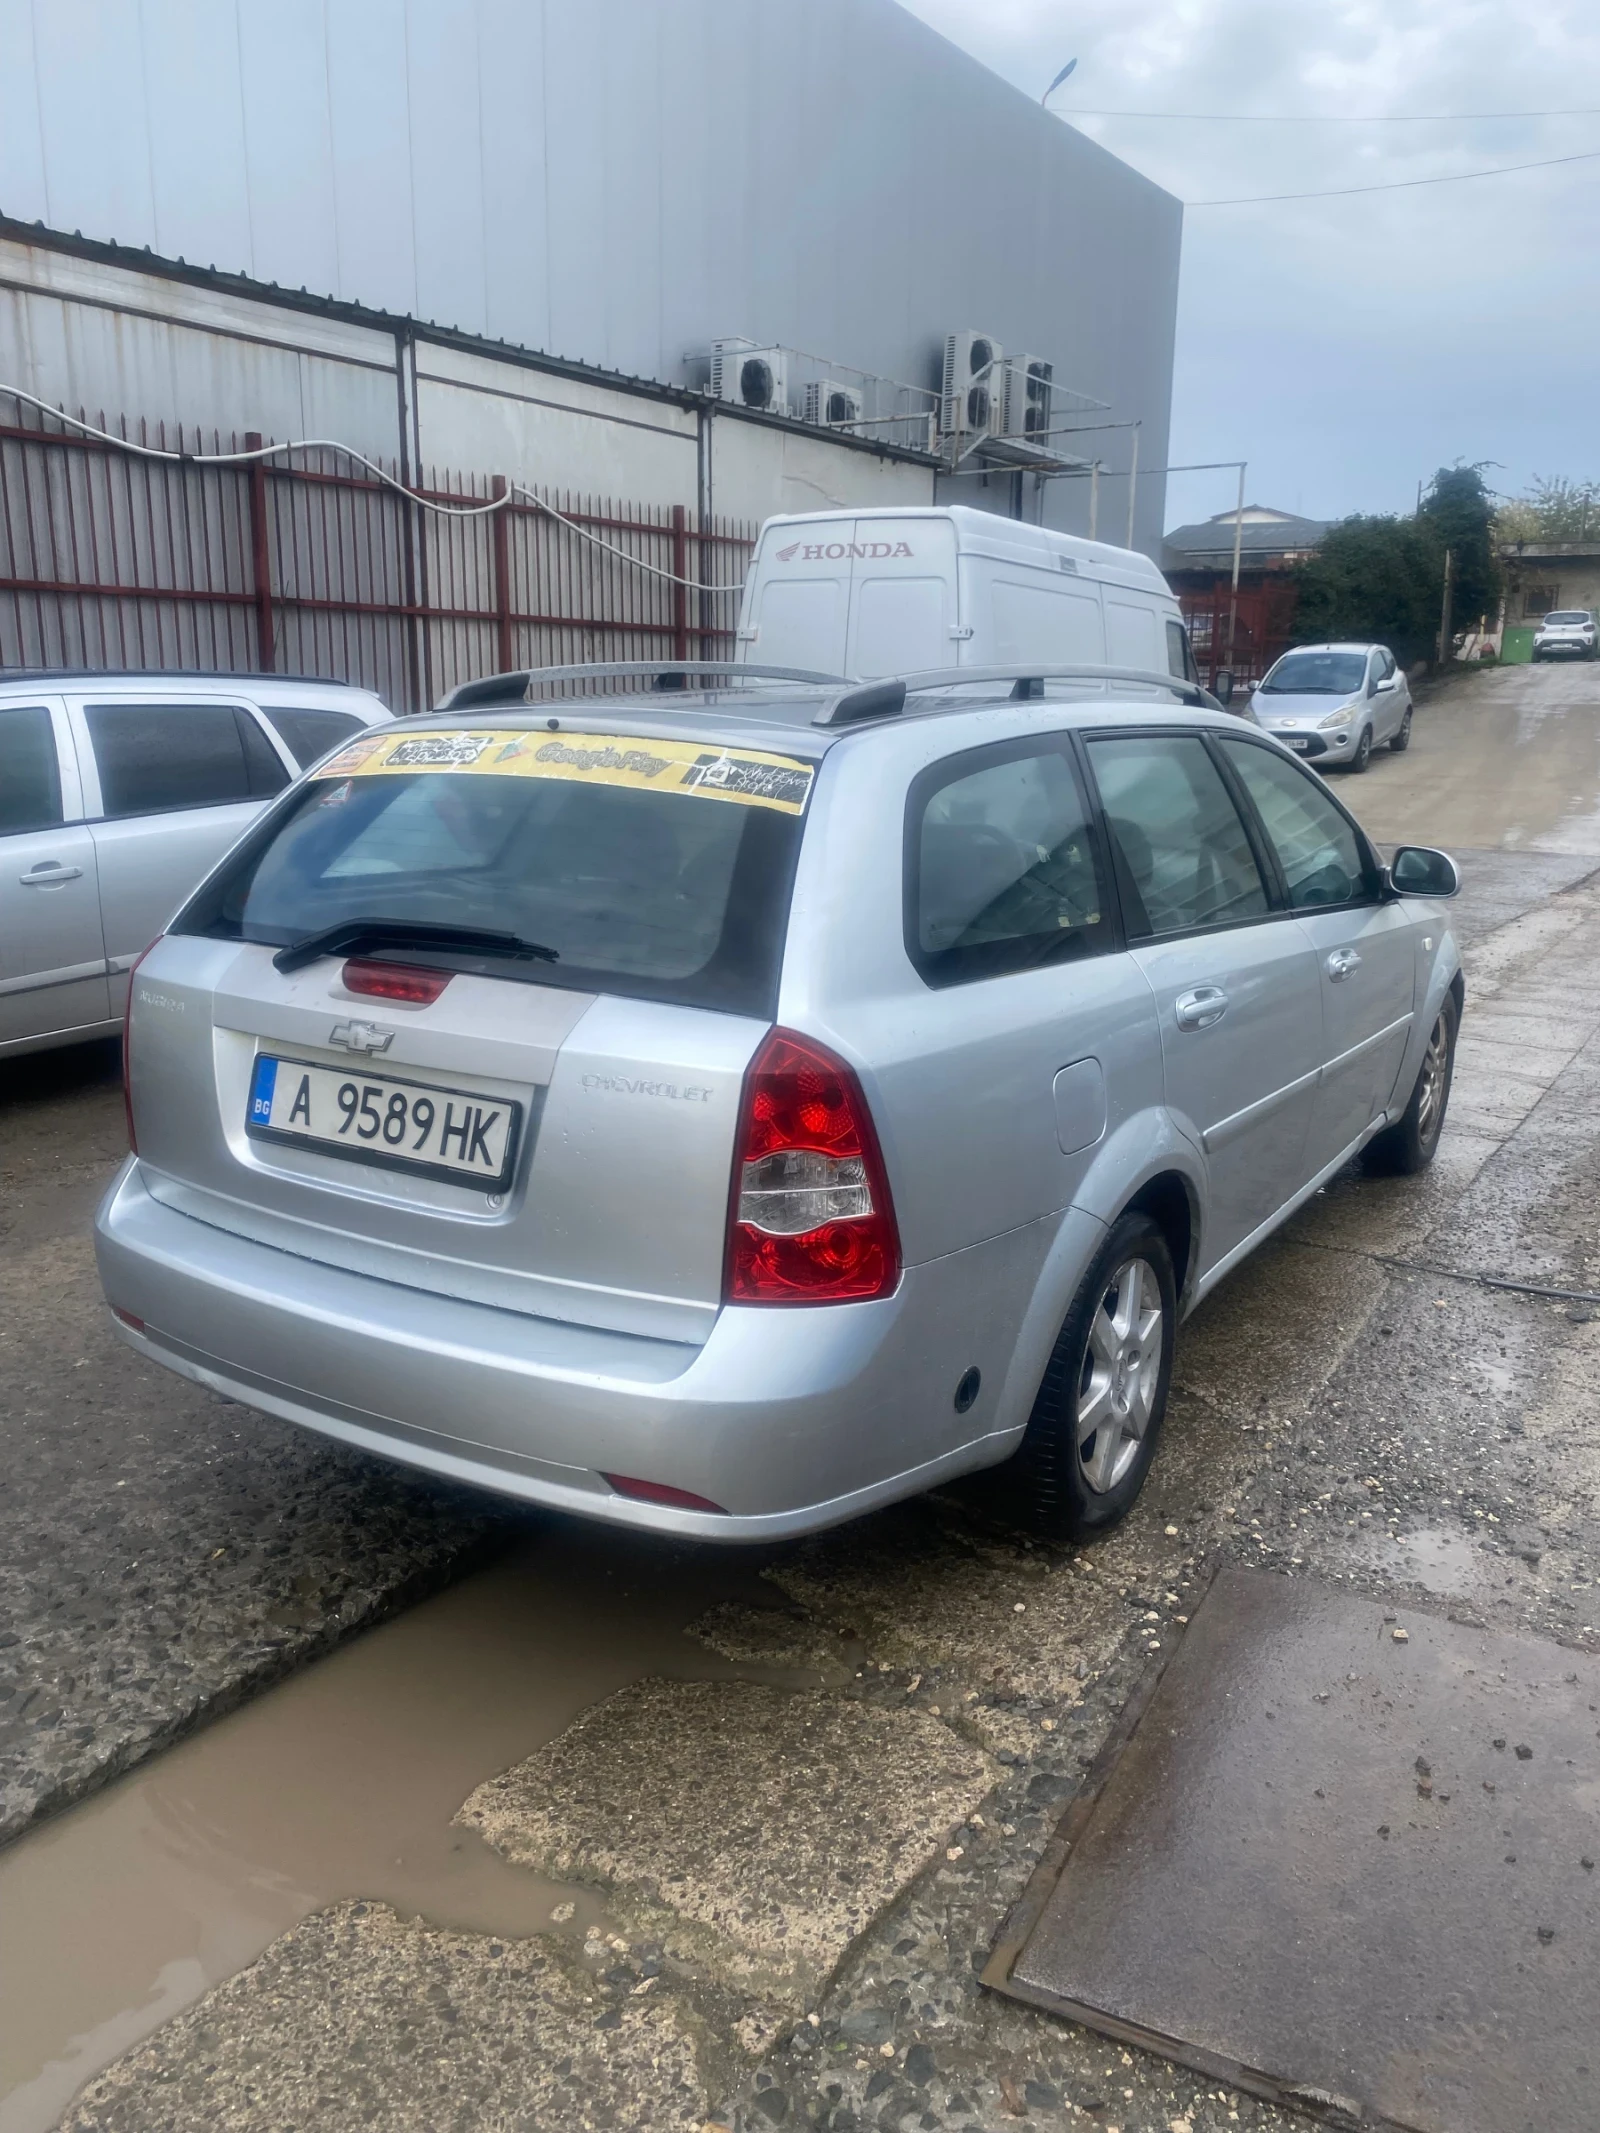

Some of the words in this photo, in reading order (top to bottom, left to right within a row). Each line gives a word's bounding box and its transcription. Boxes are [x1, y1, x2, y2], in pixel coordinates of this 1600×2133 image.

[801, 542, 915, 560] HONDA
[535, 742, 621, 771] Google
[615, 750, 673, 777] Play
[288, 1074, 311, 1126] A
[581, 1073, 714, 1101] CHEVROLET
[254, 1099, 270, 1115] BG
